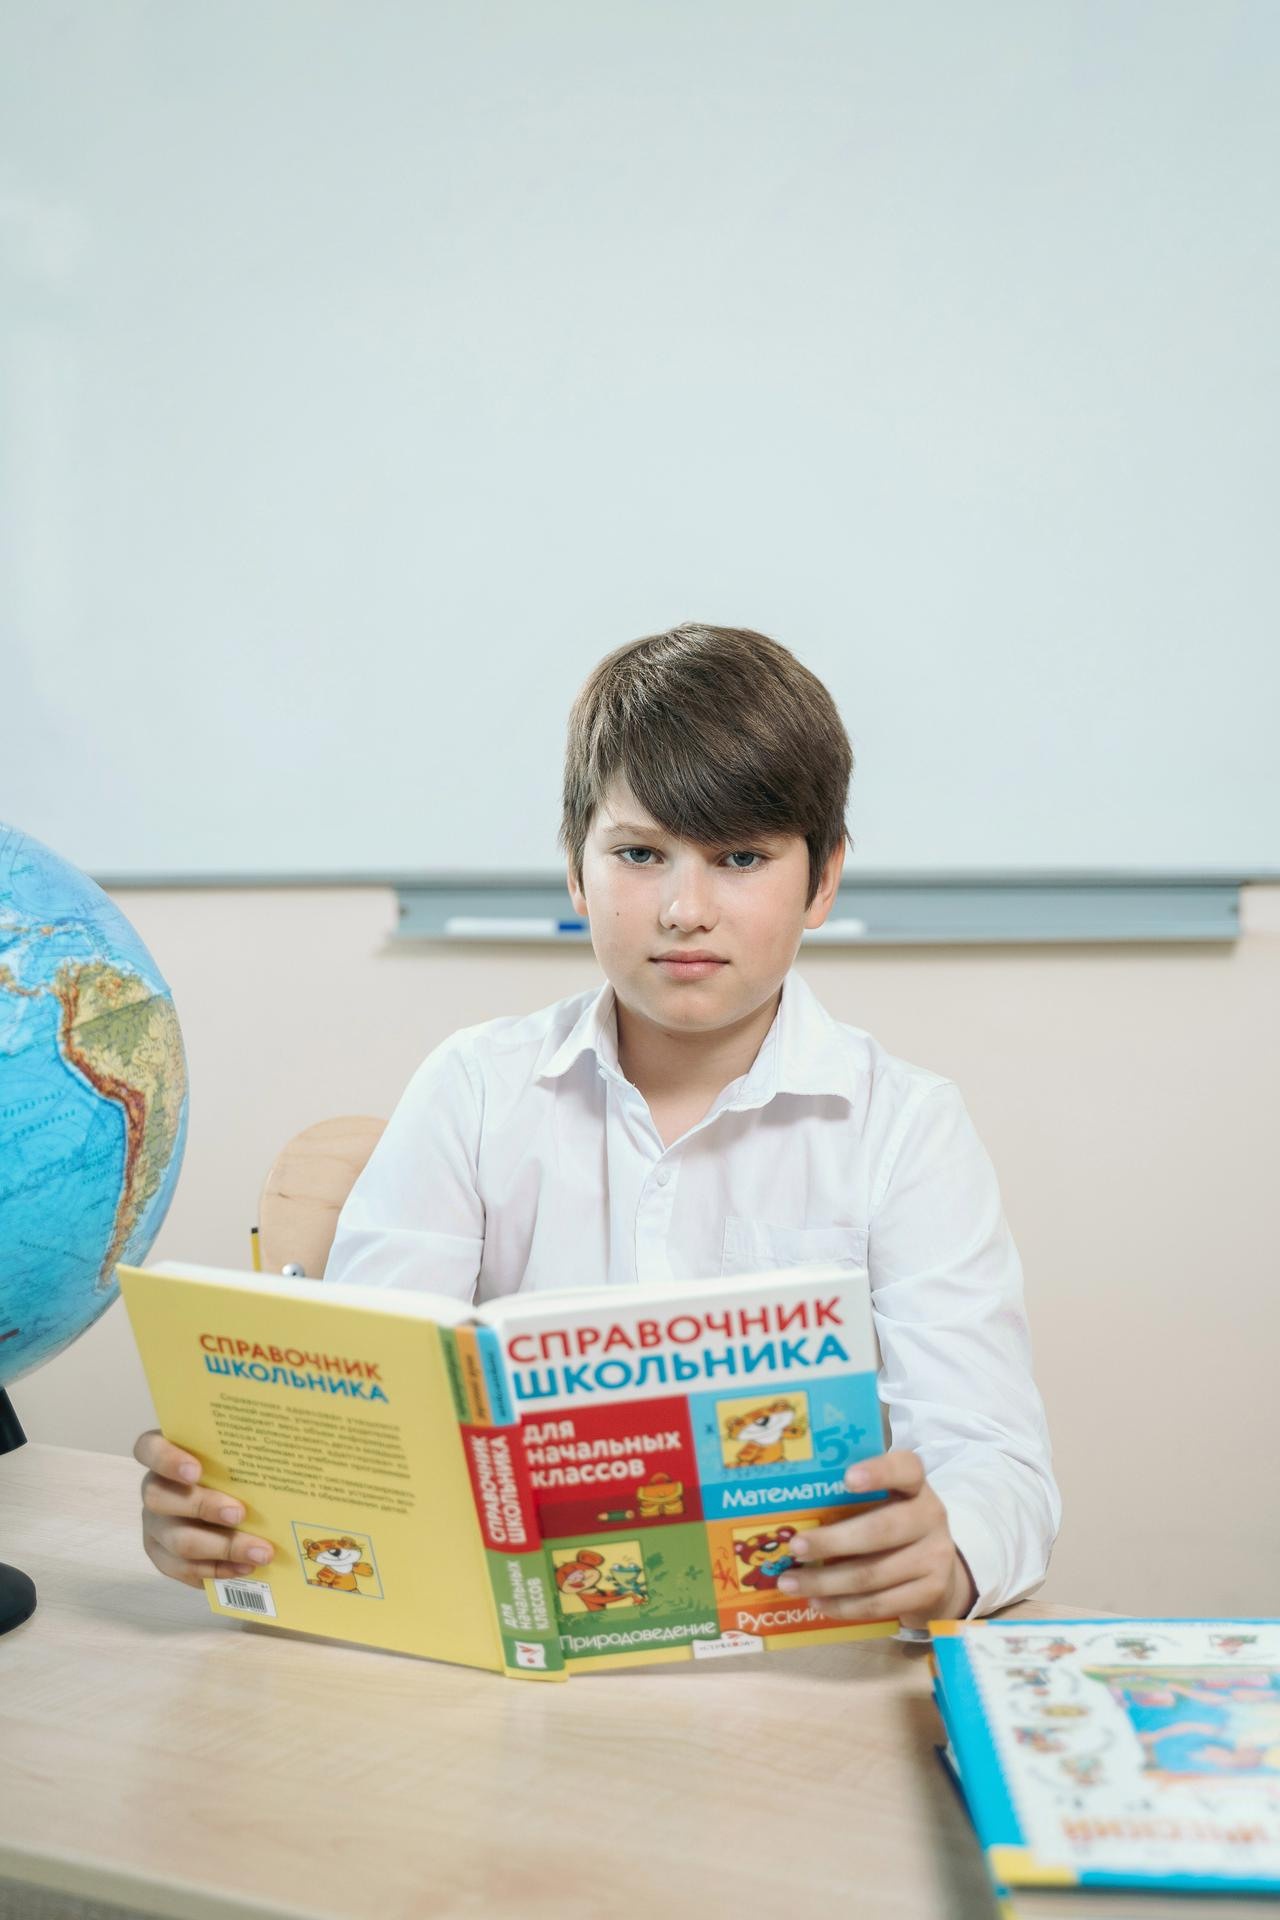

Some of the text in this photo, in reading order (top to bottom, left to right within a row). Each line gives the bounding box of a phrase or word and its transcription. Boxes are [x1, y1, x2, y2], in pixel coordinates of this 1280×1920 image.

[508, 1297, 844, 1364] СПРАВОЧНИК
[200, 1334, 382, 1381] СПРАВОЧНИК
[204, 1354, 390, 1404] ШКОЛЬНИКА
[513, 1334, 850, 1400] ШКОЛЬНИКА
[523, 1420, 575, 1446] для
[527, 1431, 682, 1465] начальных
[471, 1435, 507, 1544] СПРАВОЧНИК
[490, 1434, 527, 1545] ШКОЛЬНИКА
[531, 1459, 646, 1488] классов
[507, 1560, 532, 1630] начальных
[527, 1577, 549, 1630] классов
[559, 1622, 716, 1651] Природоведение
